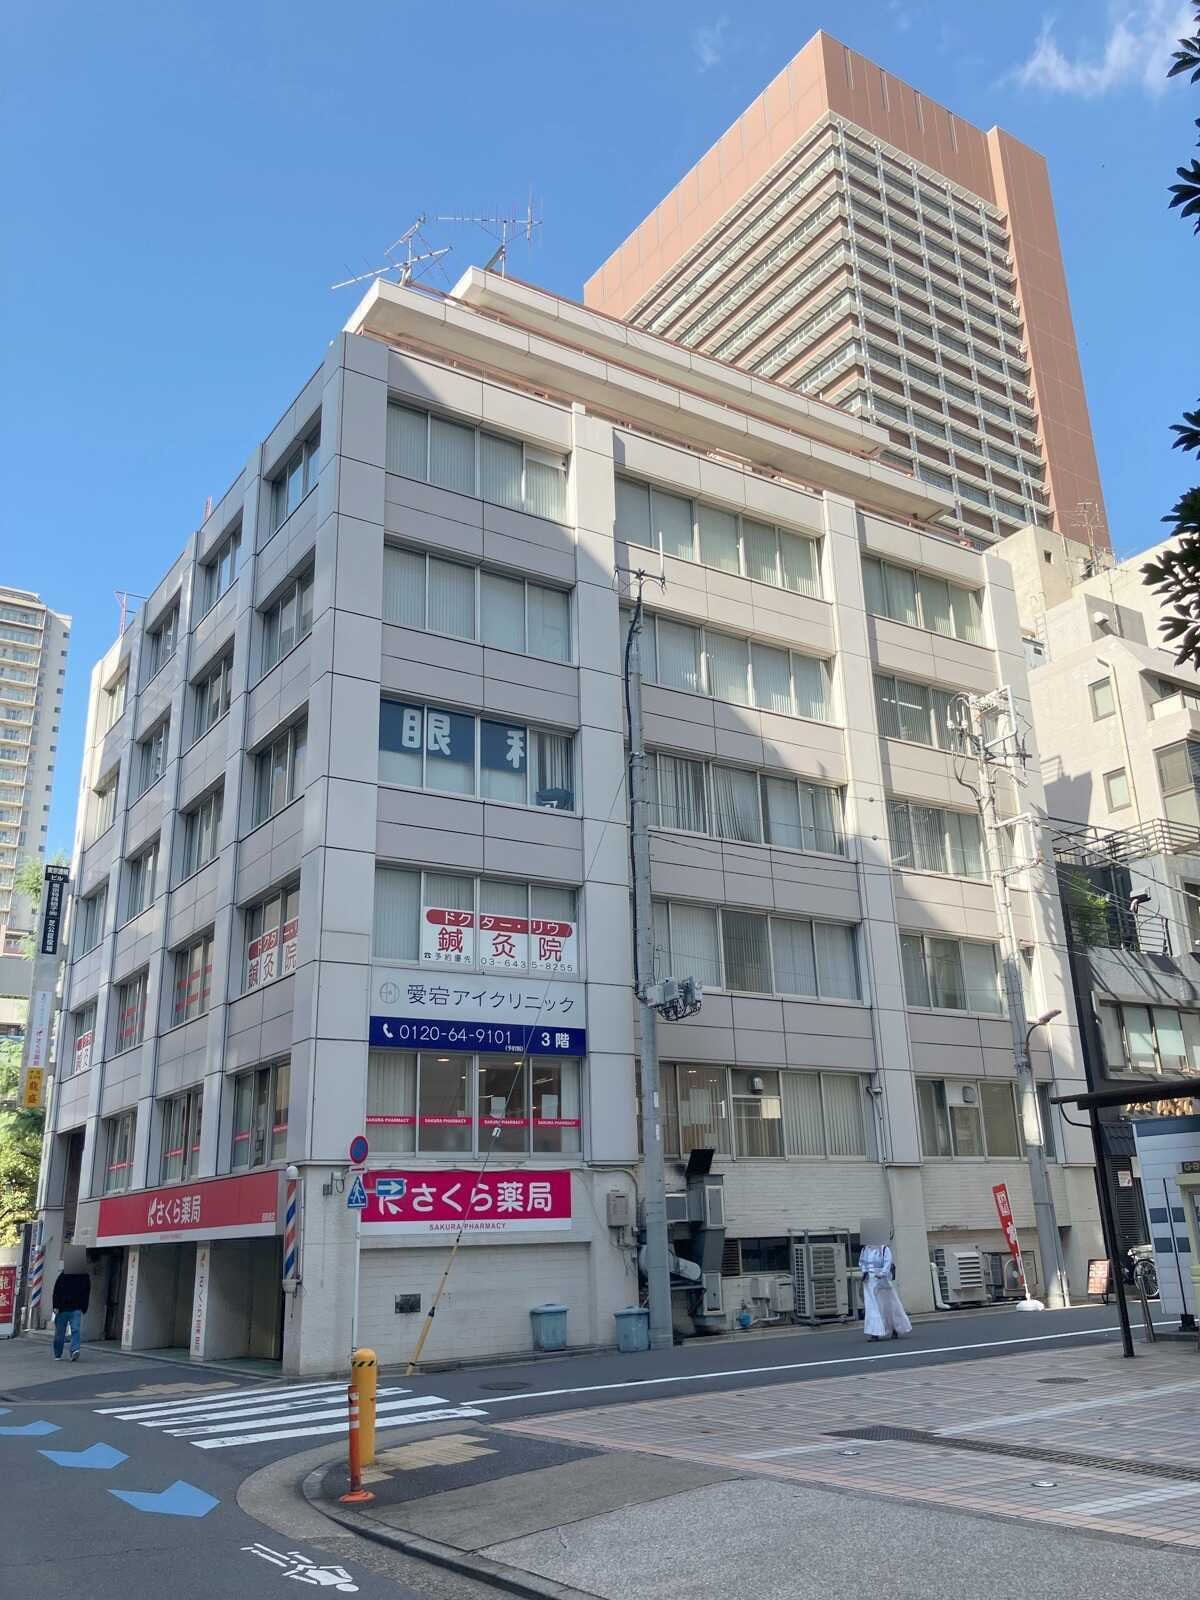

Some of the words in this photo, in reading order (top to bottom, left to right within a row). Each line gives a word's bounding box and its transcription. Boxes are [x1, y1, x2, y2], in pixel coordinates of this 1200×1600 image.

[438, 928, 562, 962] 鍼灸院
[480, 957, 573, 972] 03-6435-8255
[407, 984, 575, 1013] 愛宕アイクリニック
[399, 1024, 511, 1045] 0120-64-9101
[156, 1195, 201, 1224] さくら薬局
[411, 1181, 552, 1212] さくら薬局
[429, 1223, 461, 1231] SAKURA
[463, 1222, 507, 1230] PHARMACY
